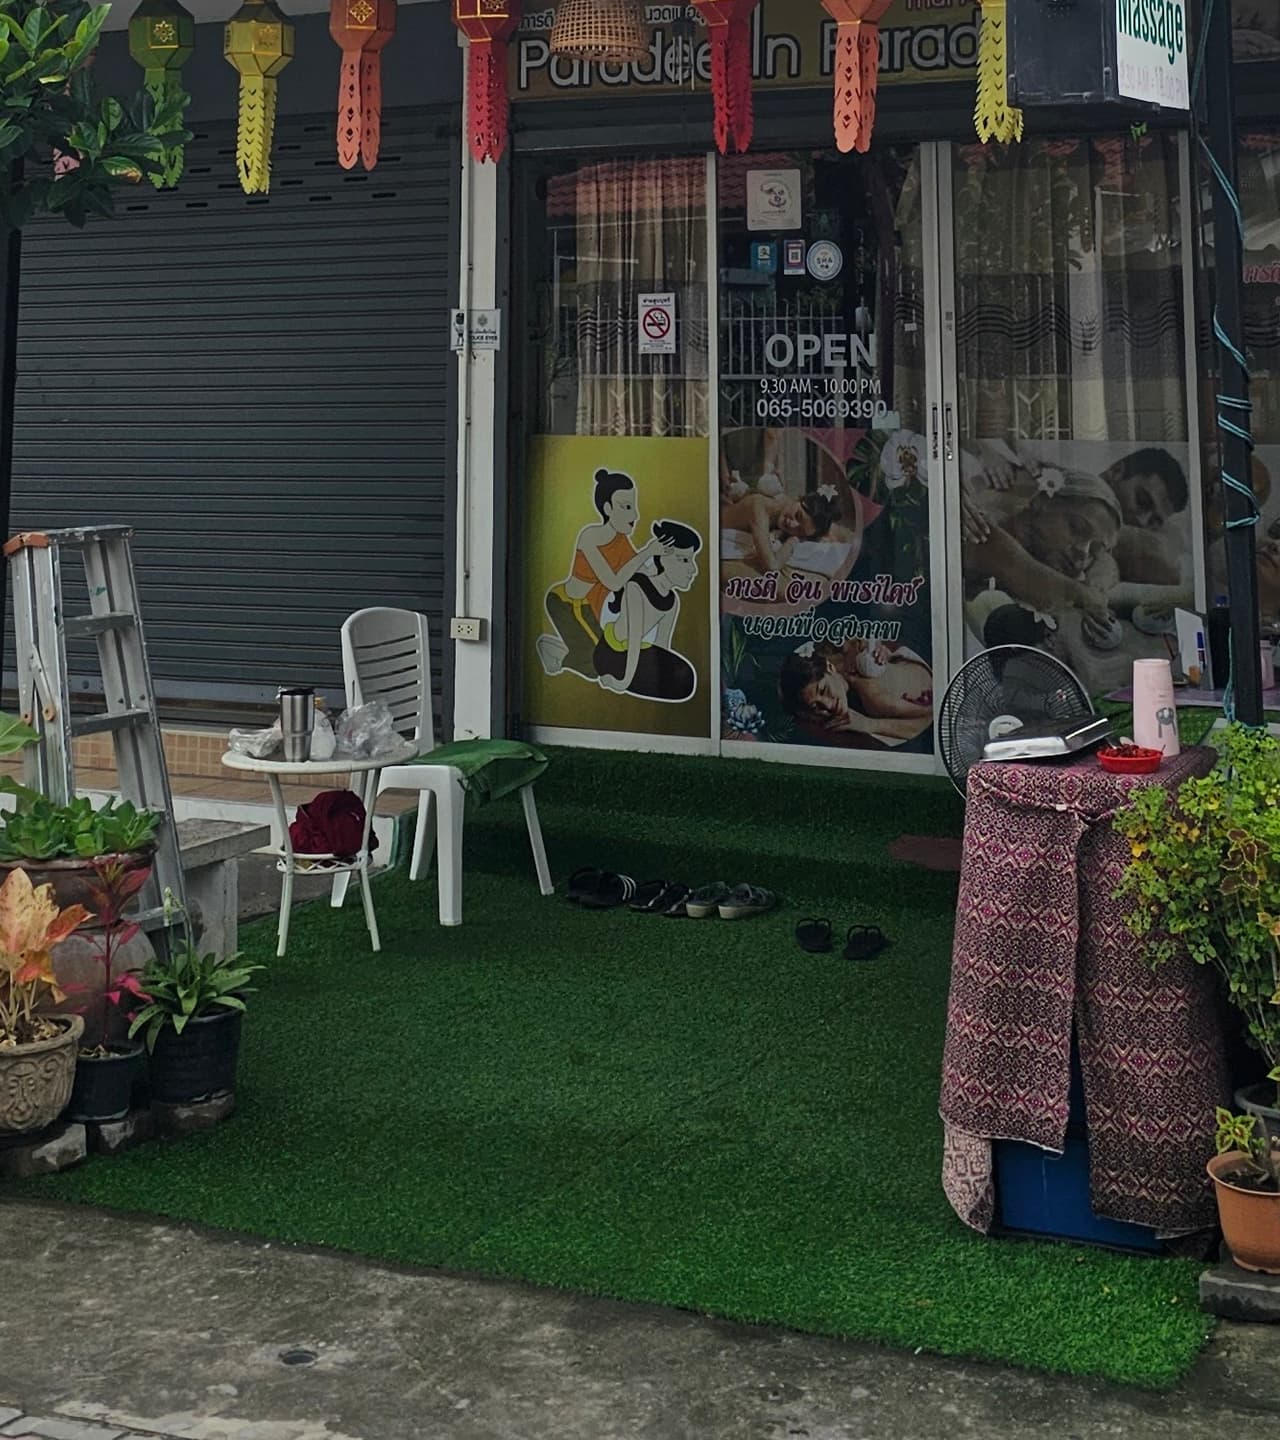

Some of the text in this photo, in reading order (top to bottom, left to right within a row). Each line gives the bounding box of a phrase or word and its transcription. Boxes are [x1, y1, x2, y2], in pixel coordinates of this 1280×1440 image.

[753, 2, 798, 76] In
[765, 333, 877, 368] OPEN
[760, 378, 787, 393] 9.30
[790, 379, 811, 393] AM
[824, 378, 857, 393] 10.00
[861, 379, 881, 394] PM
[756, 399, 887, 418] 065-5069390
[726, 571, 779, 599] ภารดี
[785, 572, 822, 604] อิน
[743, 606, 901, 647] นวดเพื่อสุขภาพ
